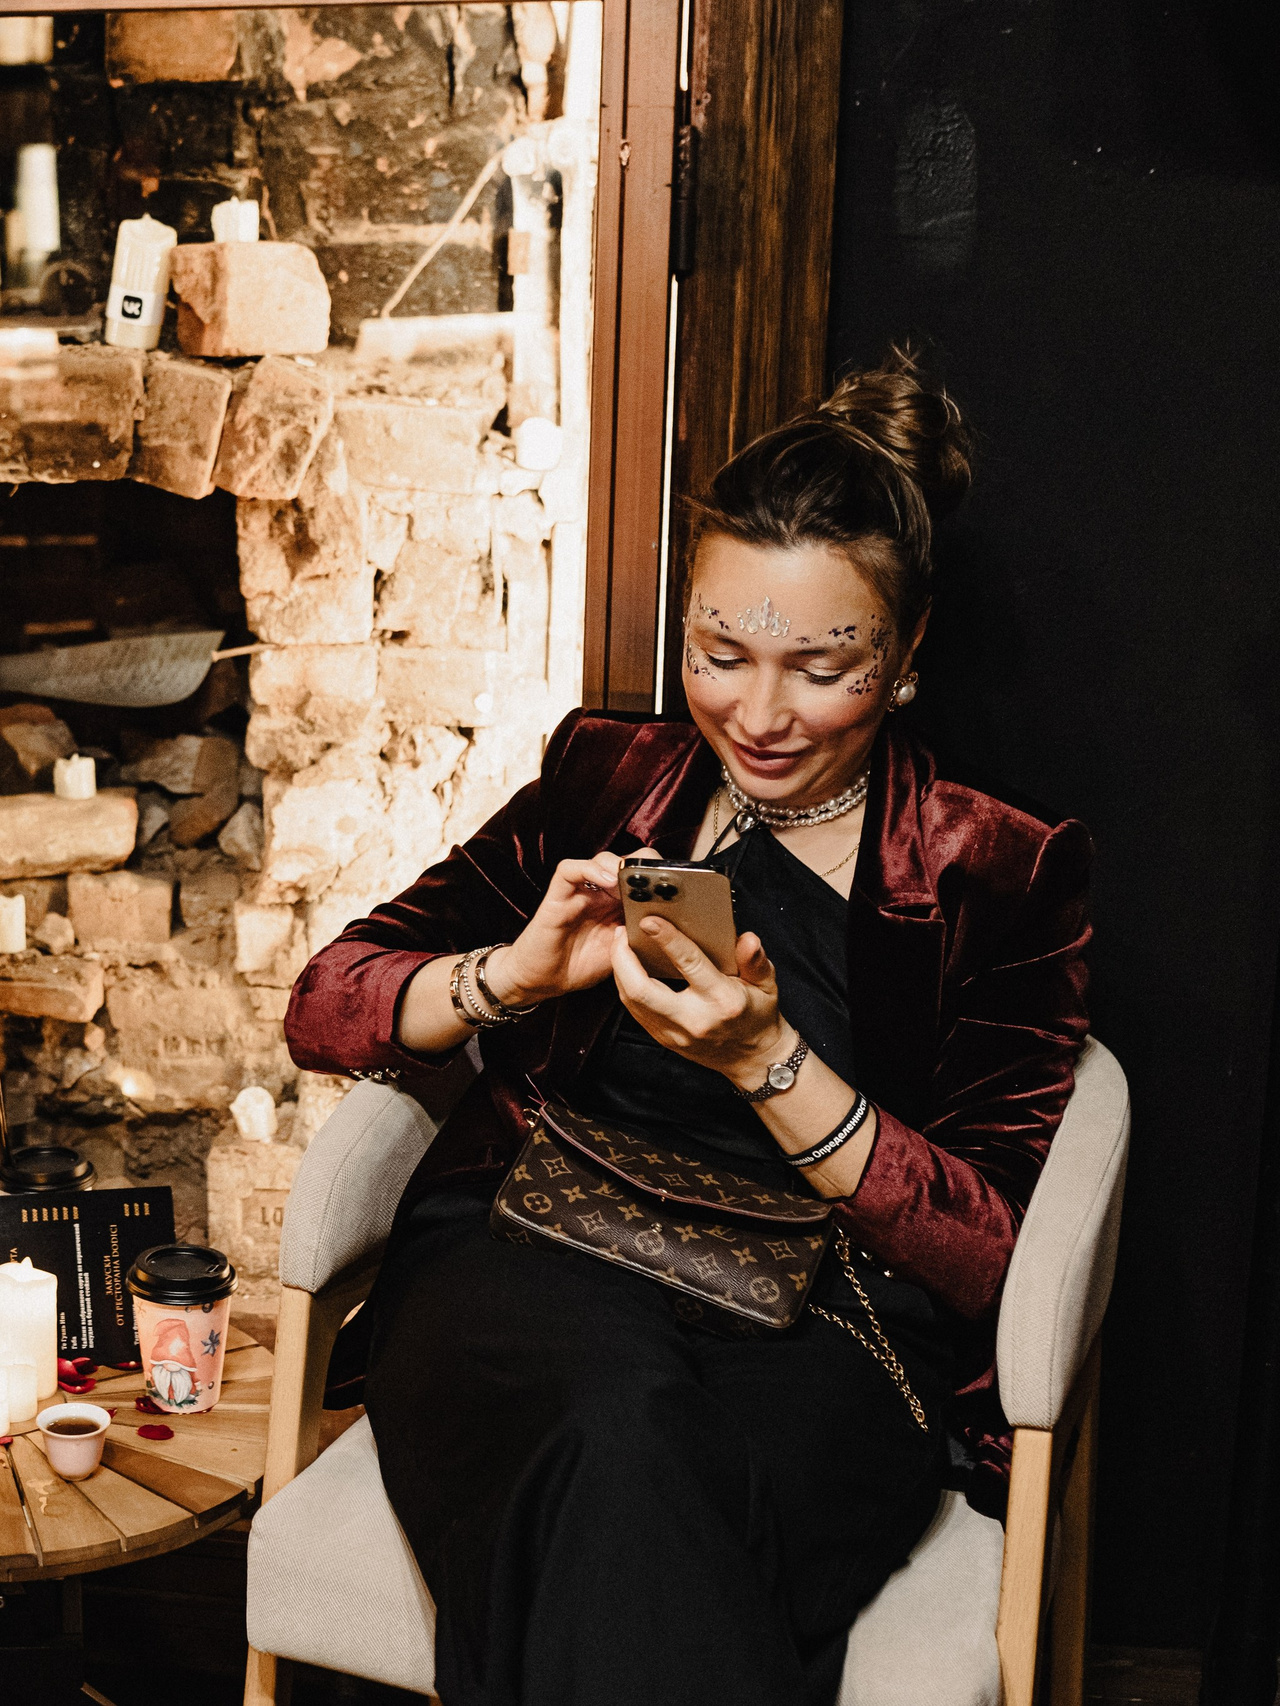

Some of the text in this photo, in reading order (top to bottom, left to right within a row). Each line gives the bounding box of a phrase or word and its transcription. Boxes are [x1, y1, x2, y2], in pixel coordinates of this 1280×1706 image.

[73, 1223, 83, 1265] керамической
[104, 1255, 113, 1296] ЗАКУСКИ
[110, 1224, 124, 1326] ОТ РЕСТОРАНА DODICI
